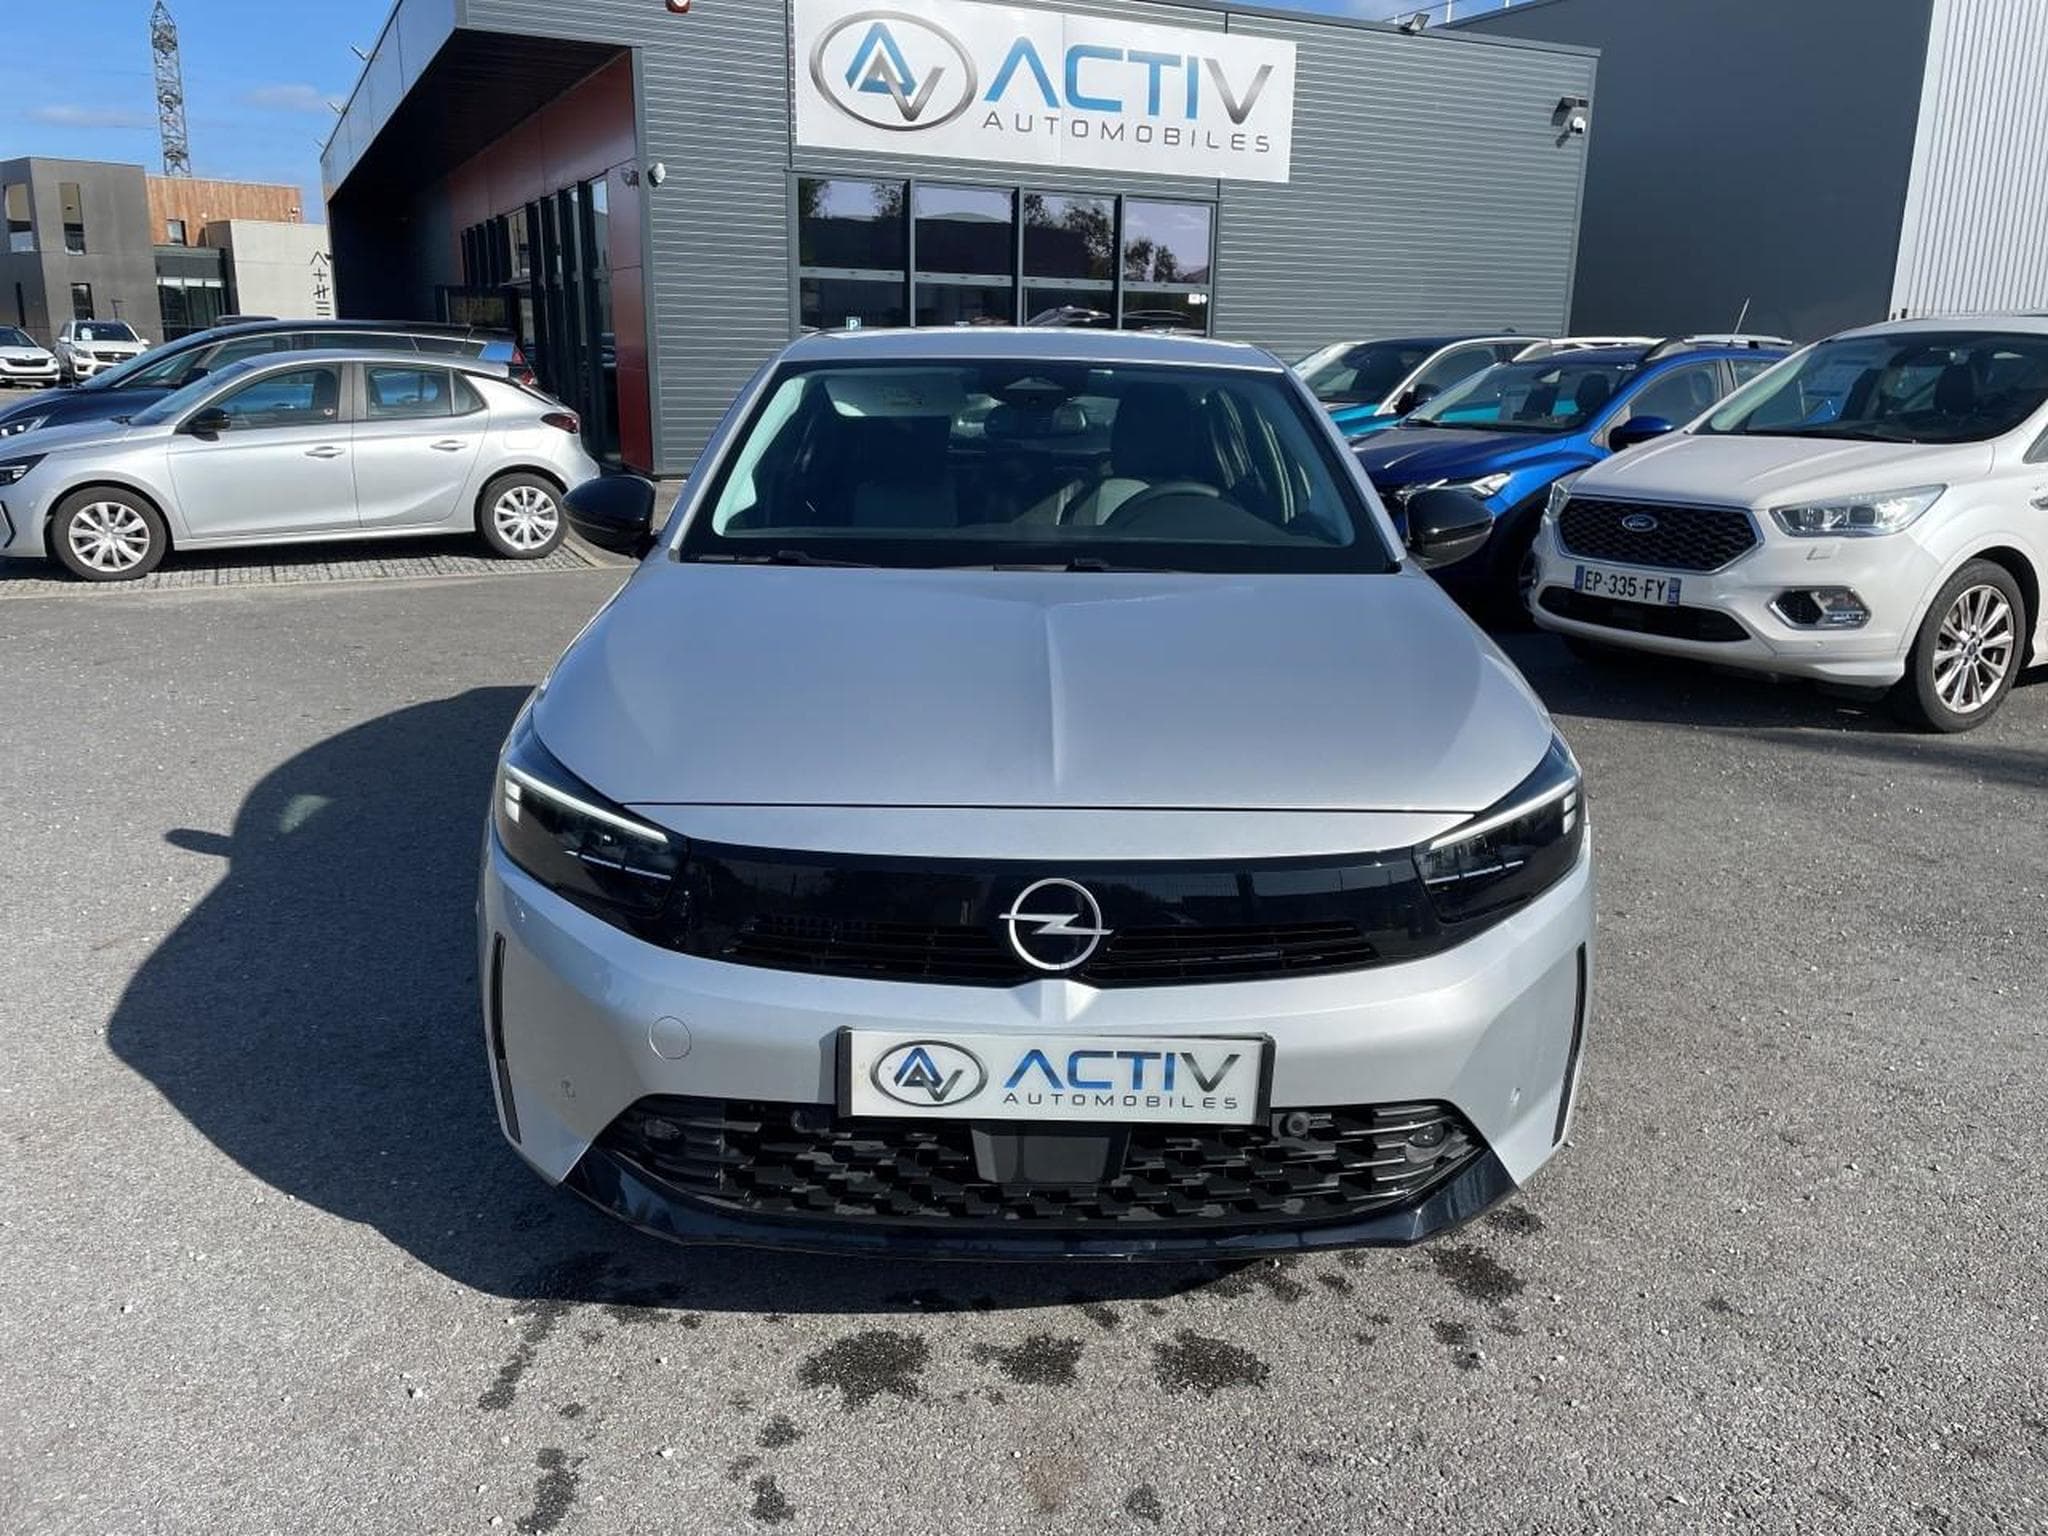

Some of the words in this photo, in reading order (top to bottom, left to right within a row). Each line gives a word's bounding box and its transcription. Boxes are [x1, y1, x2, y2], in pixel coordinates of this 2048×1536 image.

[984, 37, 1274, 125] ACTIV
[982, 111, 1270, 153] AUTOMOBILES
[1005, 1049, 1240, 1092] ACTIV
[1003, 1093, 1238, 1109] AUTOMOBILES
